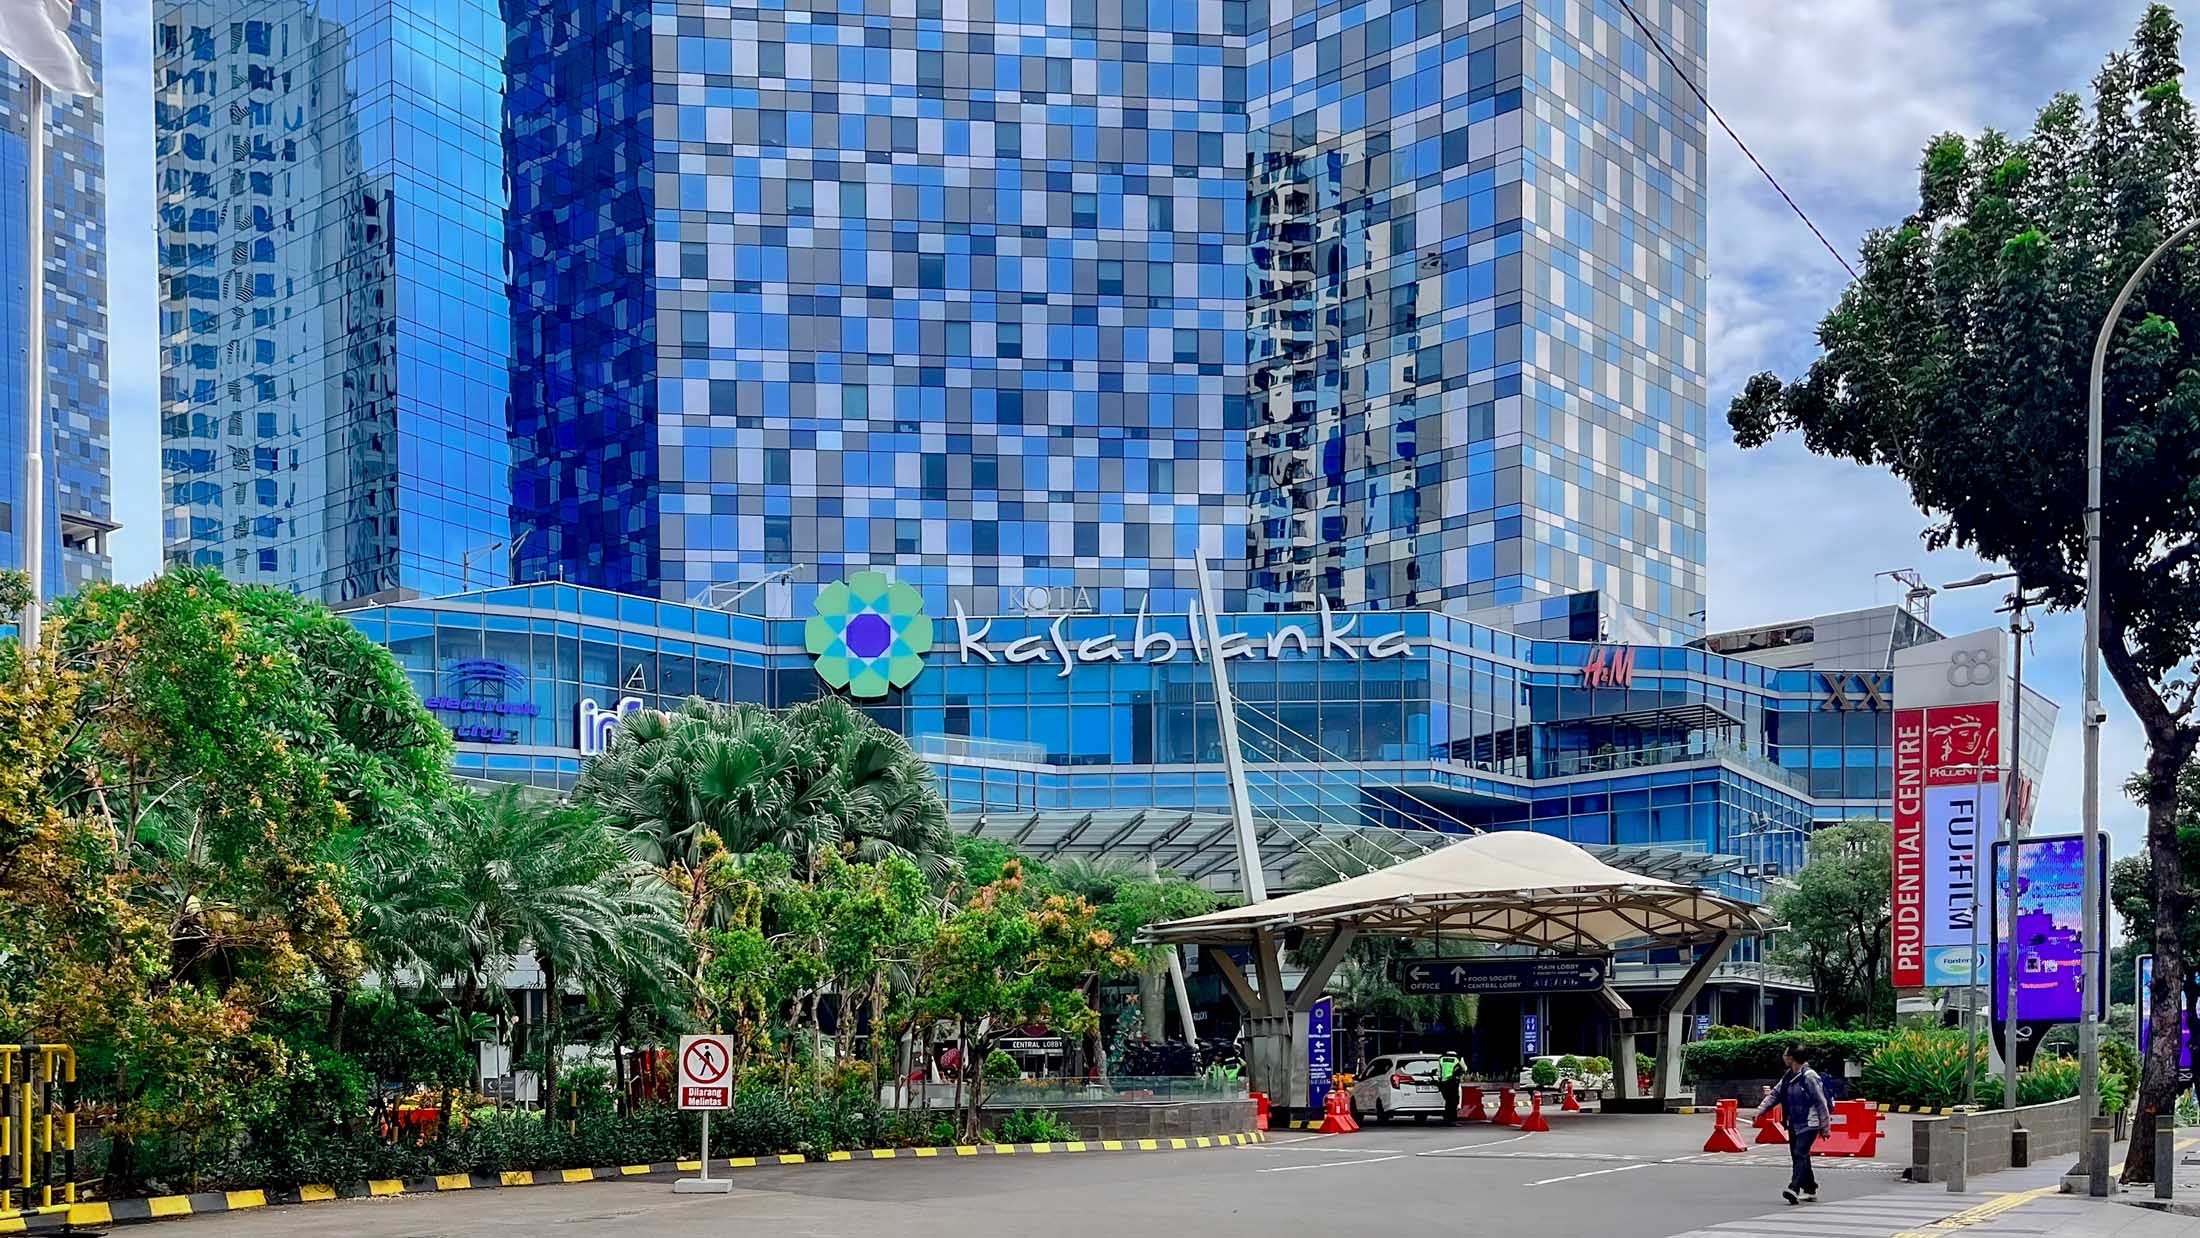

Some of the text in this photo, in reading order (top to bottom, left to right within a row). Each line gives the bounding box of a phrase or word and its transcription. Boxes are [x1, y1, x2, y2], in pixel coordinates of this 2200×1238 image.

[1008, 586, 1093, 611] KOTA
[1583, 647, 1634, 688] H&M
[457, 725, 505, 742] city
[1898, 725, 1921, 970] PRUDENTIAL CENTRE
[1949, 800, 1974, 930] FUJIFILM
[1043, 1040, 1062, 1048] LOBBY
[688, 1087, 722, 1097] Dilarang
[688, 1097, 722, 1106] Melintas
